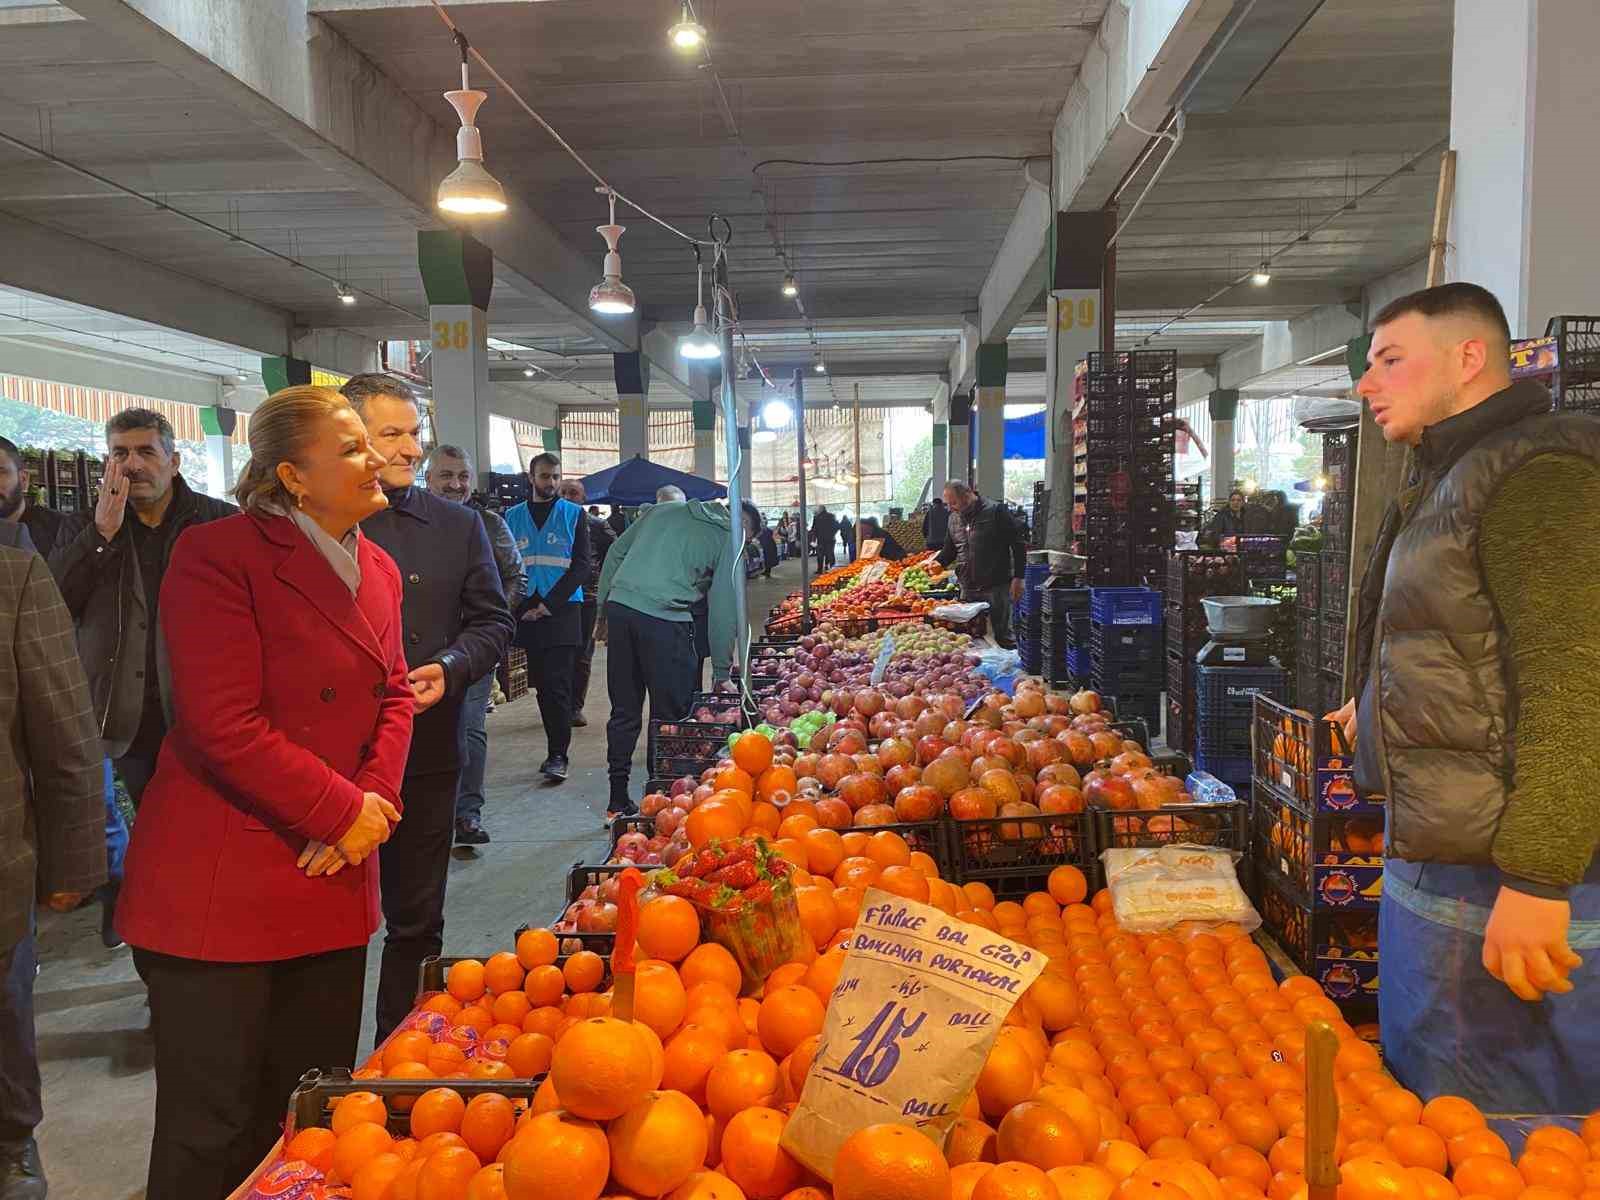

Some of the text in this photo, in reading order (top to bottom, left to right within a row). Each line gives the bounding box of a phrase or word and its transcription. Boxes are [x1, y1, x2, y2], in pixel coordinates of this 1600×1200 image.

[1058, 298, 1095, 329] 39
[433, 320, 469, 350] 38
[935, 925, 969, 946] BAL
[854, 933, 1021, 994] BAKLAVA PORTAKAL
[838, 1000, 928, 1088] 15
